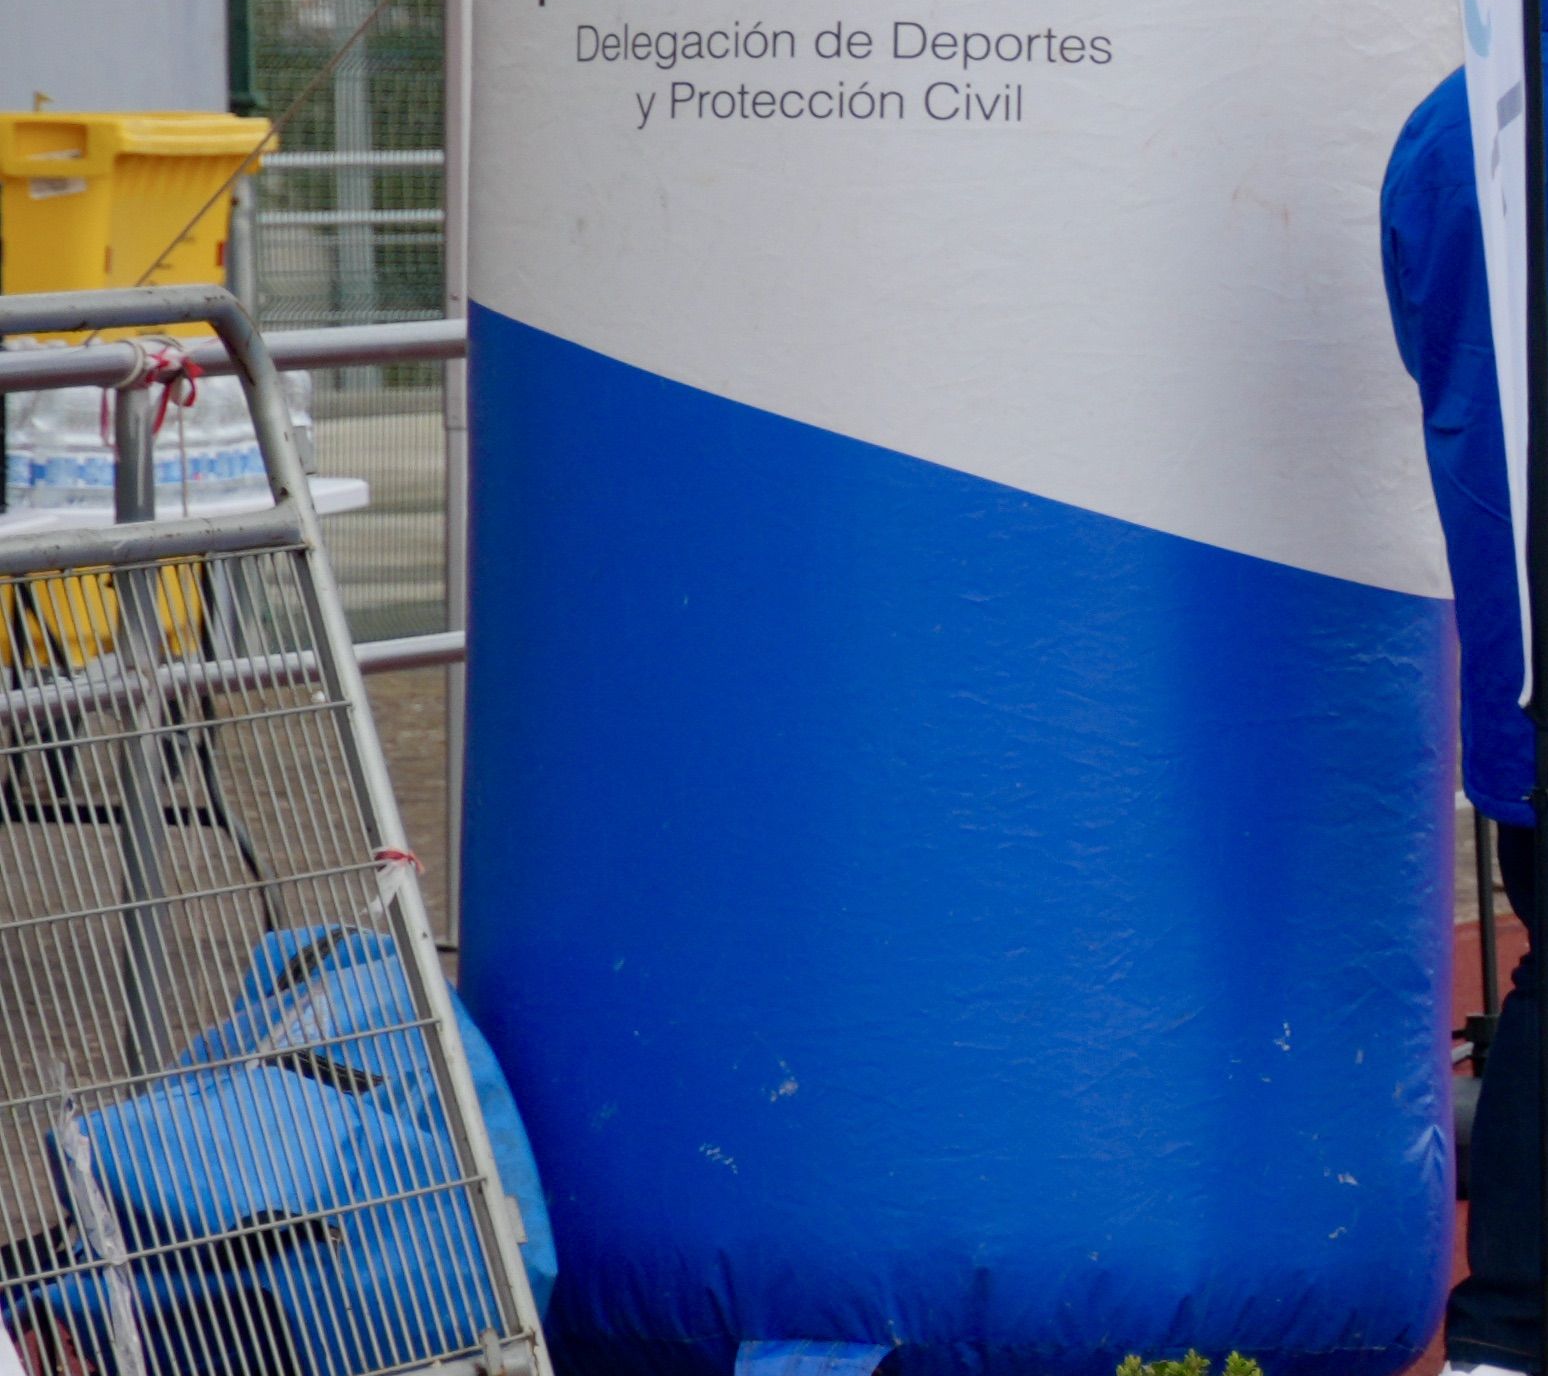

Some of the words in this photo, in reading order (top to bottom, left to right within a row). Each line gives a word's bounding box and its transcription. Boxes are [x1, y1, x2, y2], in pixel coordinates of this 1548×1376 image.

[576, 21, 795, 69] Delegación
[814, 21, 873, 59] de
[893, 22, 1113, 70] Deportes
[636, 91, 656, 130] y
[670, 81, 905, 119] Protección
[924, 81, 1022, 122] Civil
